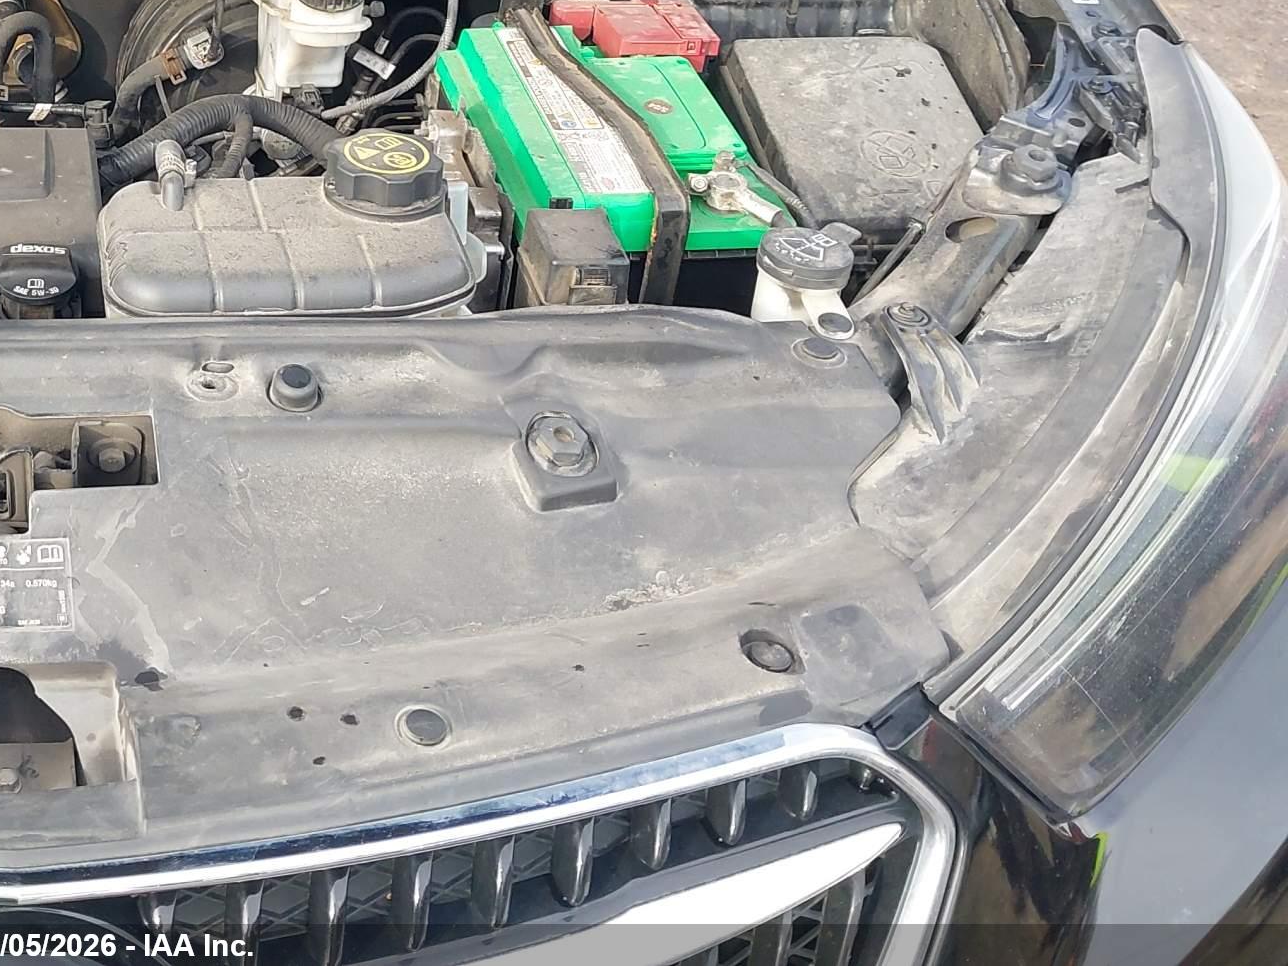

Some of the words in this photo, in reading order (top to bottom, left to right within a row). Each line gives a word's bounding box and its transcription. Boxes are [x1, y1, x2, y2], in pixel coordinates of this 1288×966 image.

[10, 243, 68, 255] dexos
[13, 285, 30, 296] SAE
[31, 286, 60, 296] 5W-30
